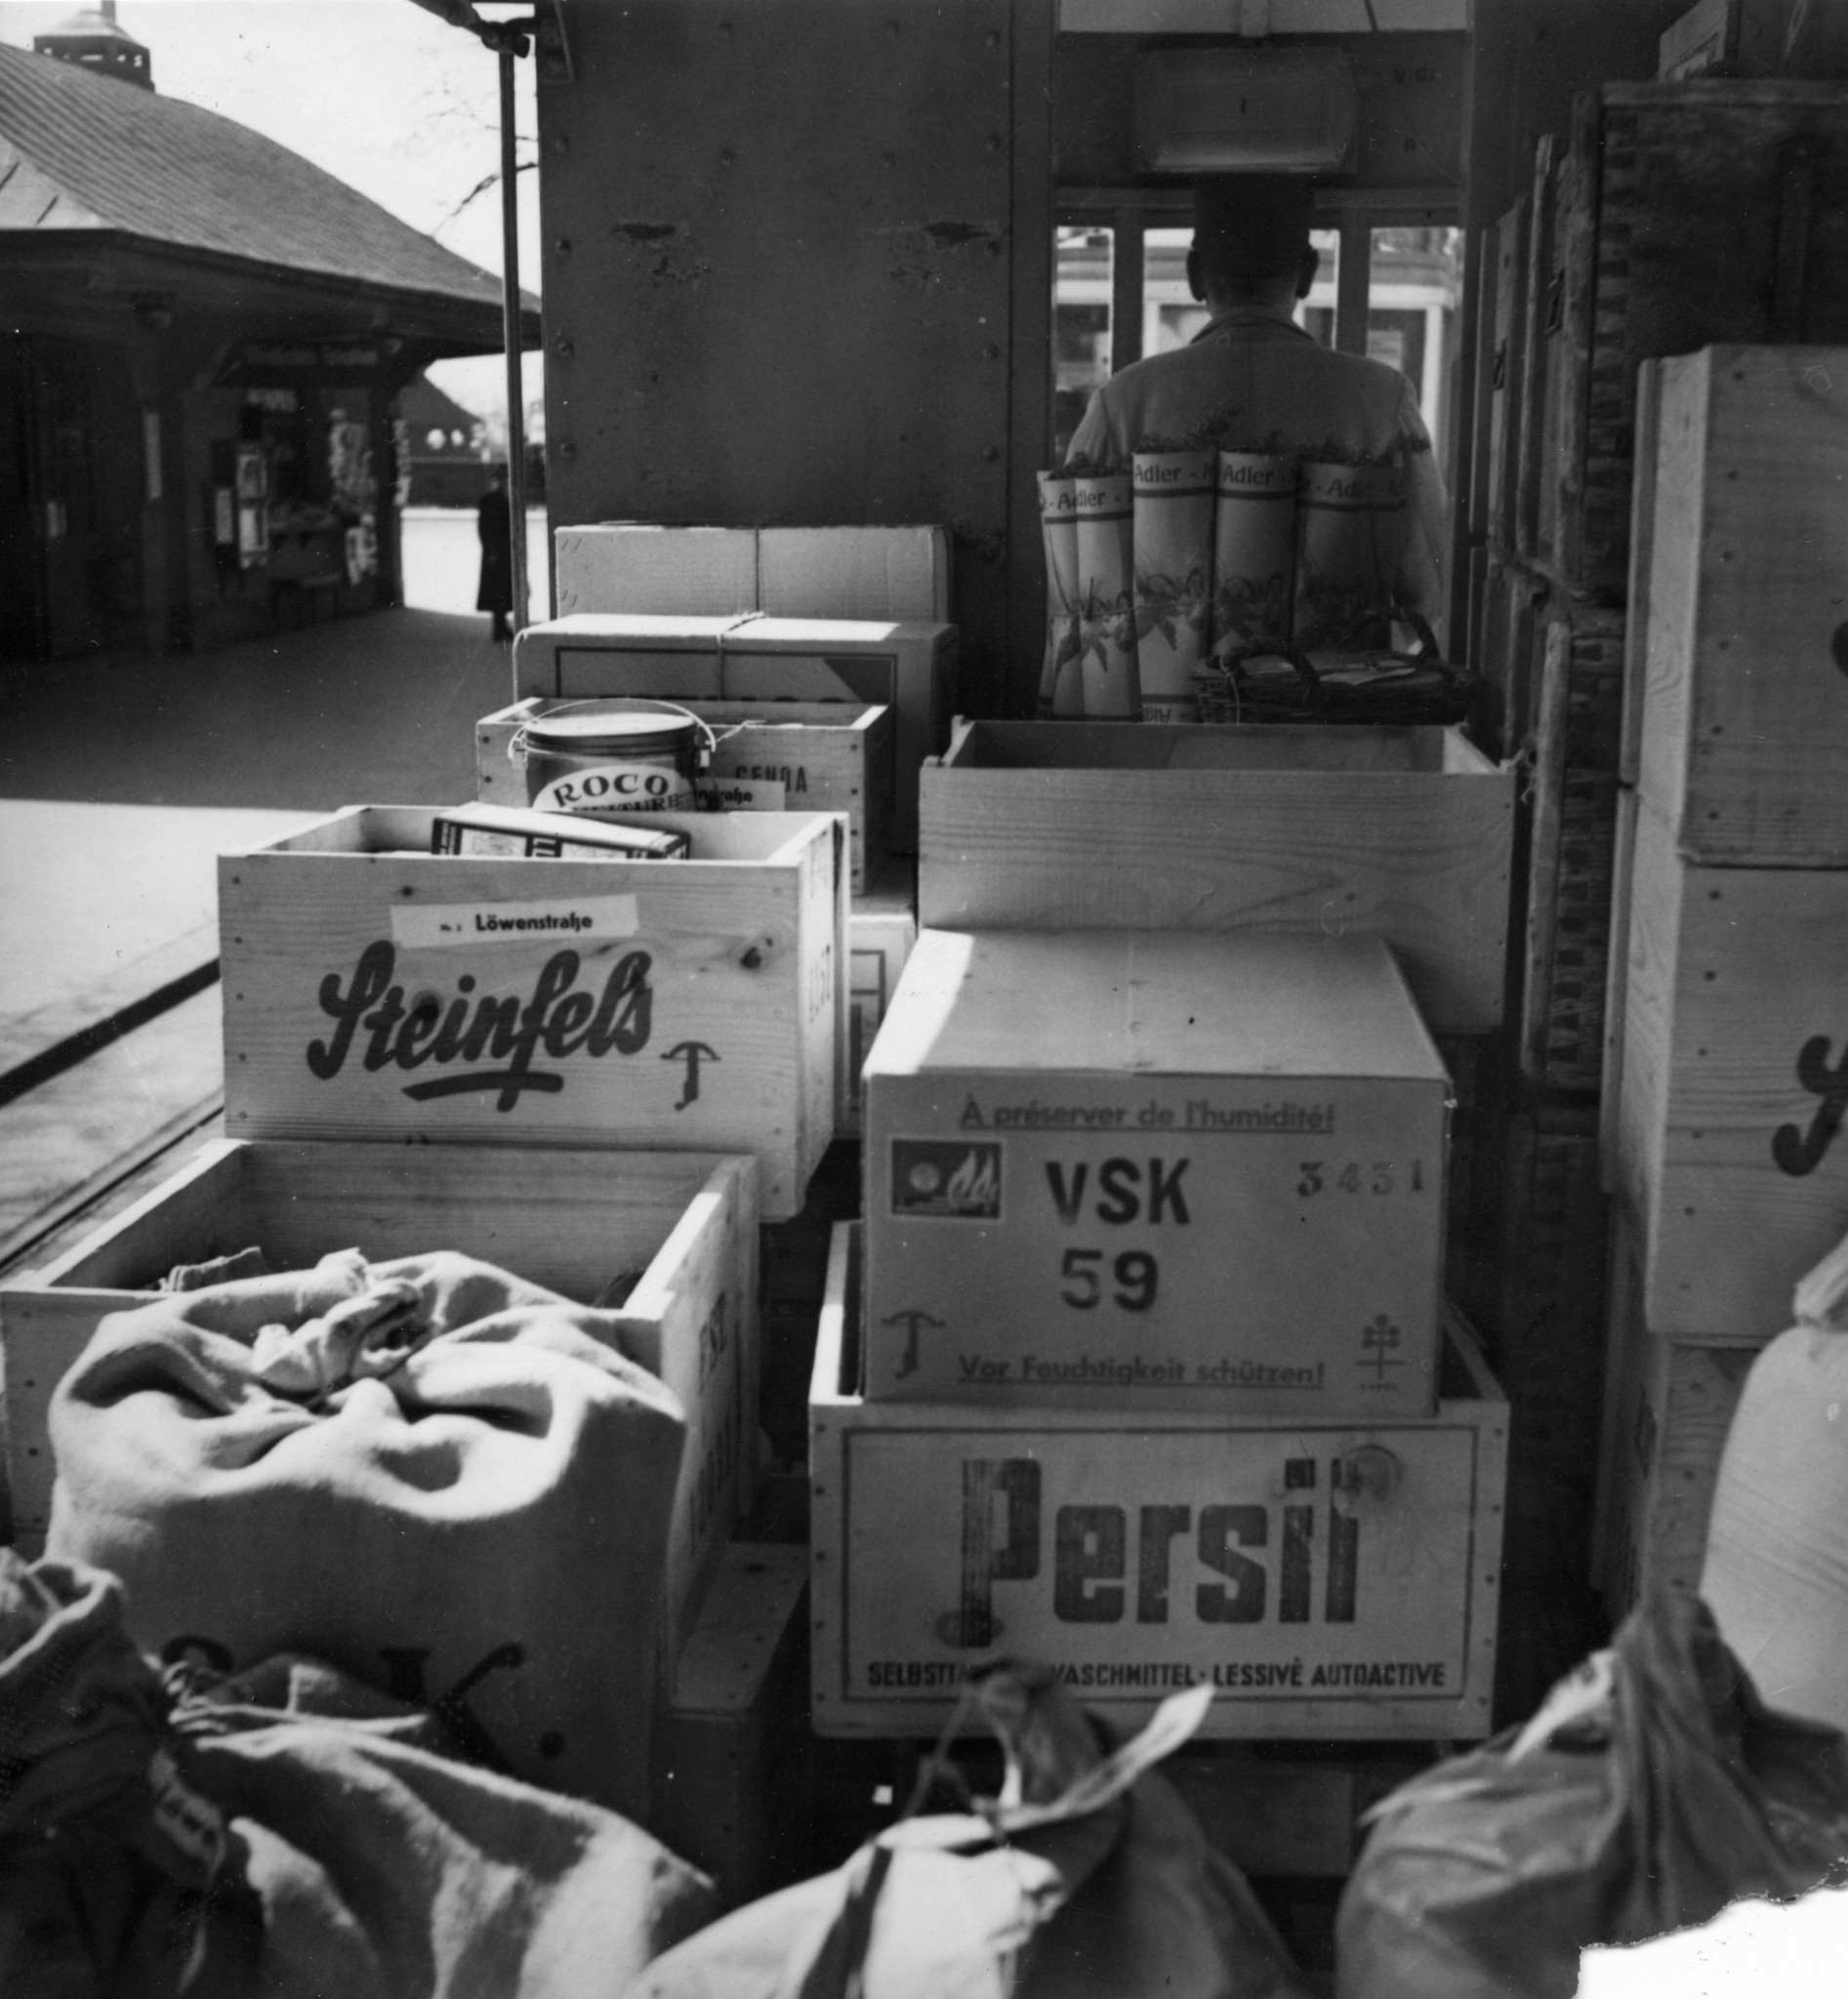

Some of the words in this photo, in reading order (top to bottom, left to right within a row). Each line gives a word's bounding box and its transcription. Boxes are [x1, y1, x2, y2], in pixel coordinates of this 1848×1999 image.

[1134, 465, 1181, 482] Adler
[1223, 465, 1273, 485] Adler
[1057, 492, 1105, 510] Adler
[553, 773, 669, 808] ROCO
[475, 912, 594, 932] Löwenstraße
[307, 940, 653, 1113] Steinfels
[994, 1099, 1127, 1128] préserver
[1138, 1098, 1175, 1126] de
[1045, 1158, 1191, 1225] VSK
[1061, 1248, 1160, 1313] 59
[959, 1355, 1009, 1378] Vor
[1021, 1354, 1185, 1385] Feuchtigkeit
[1197, 1357, 1325, 1384] schützen!
[962, 1457, 1359, 1649] Persil
[1310, 1662, 1446, 1688] AUTOACTIVE
